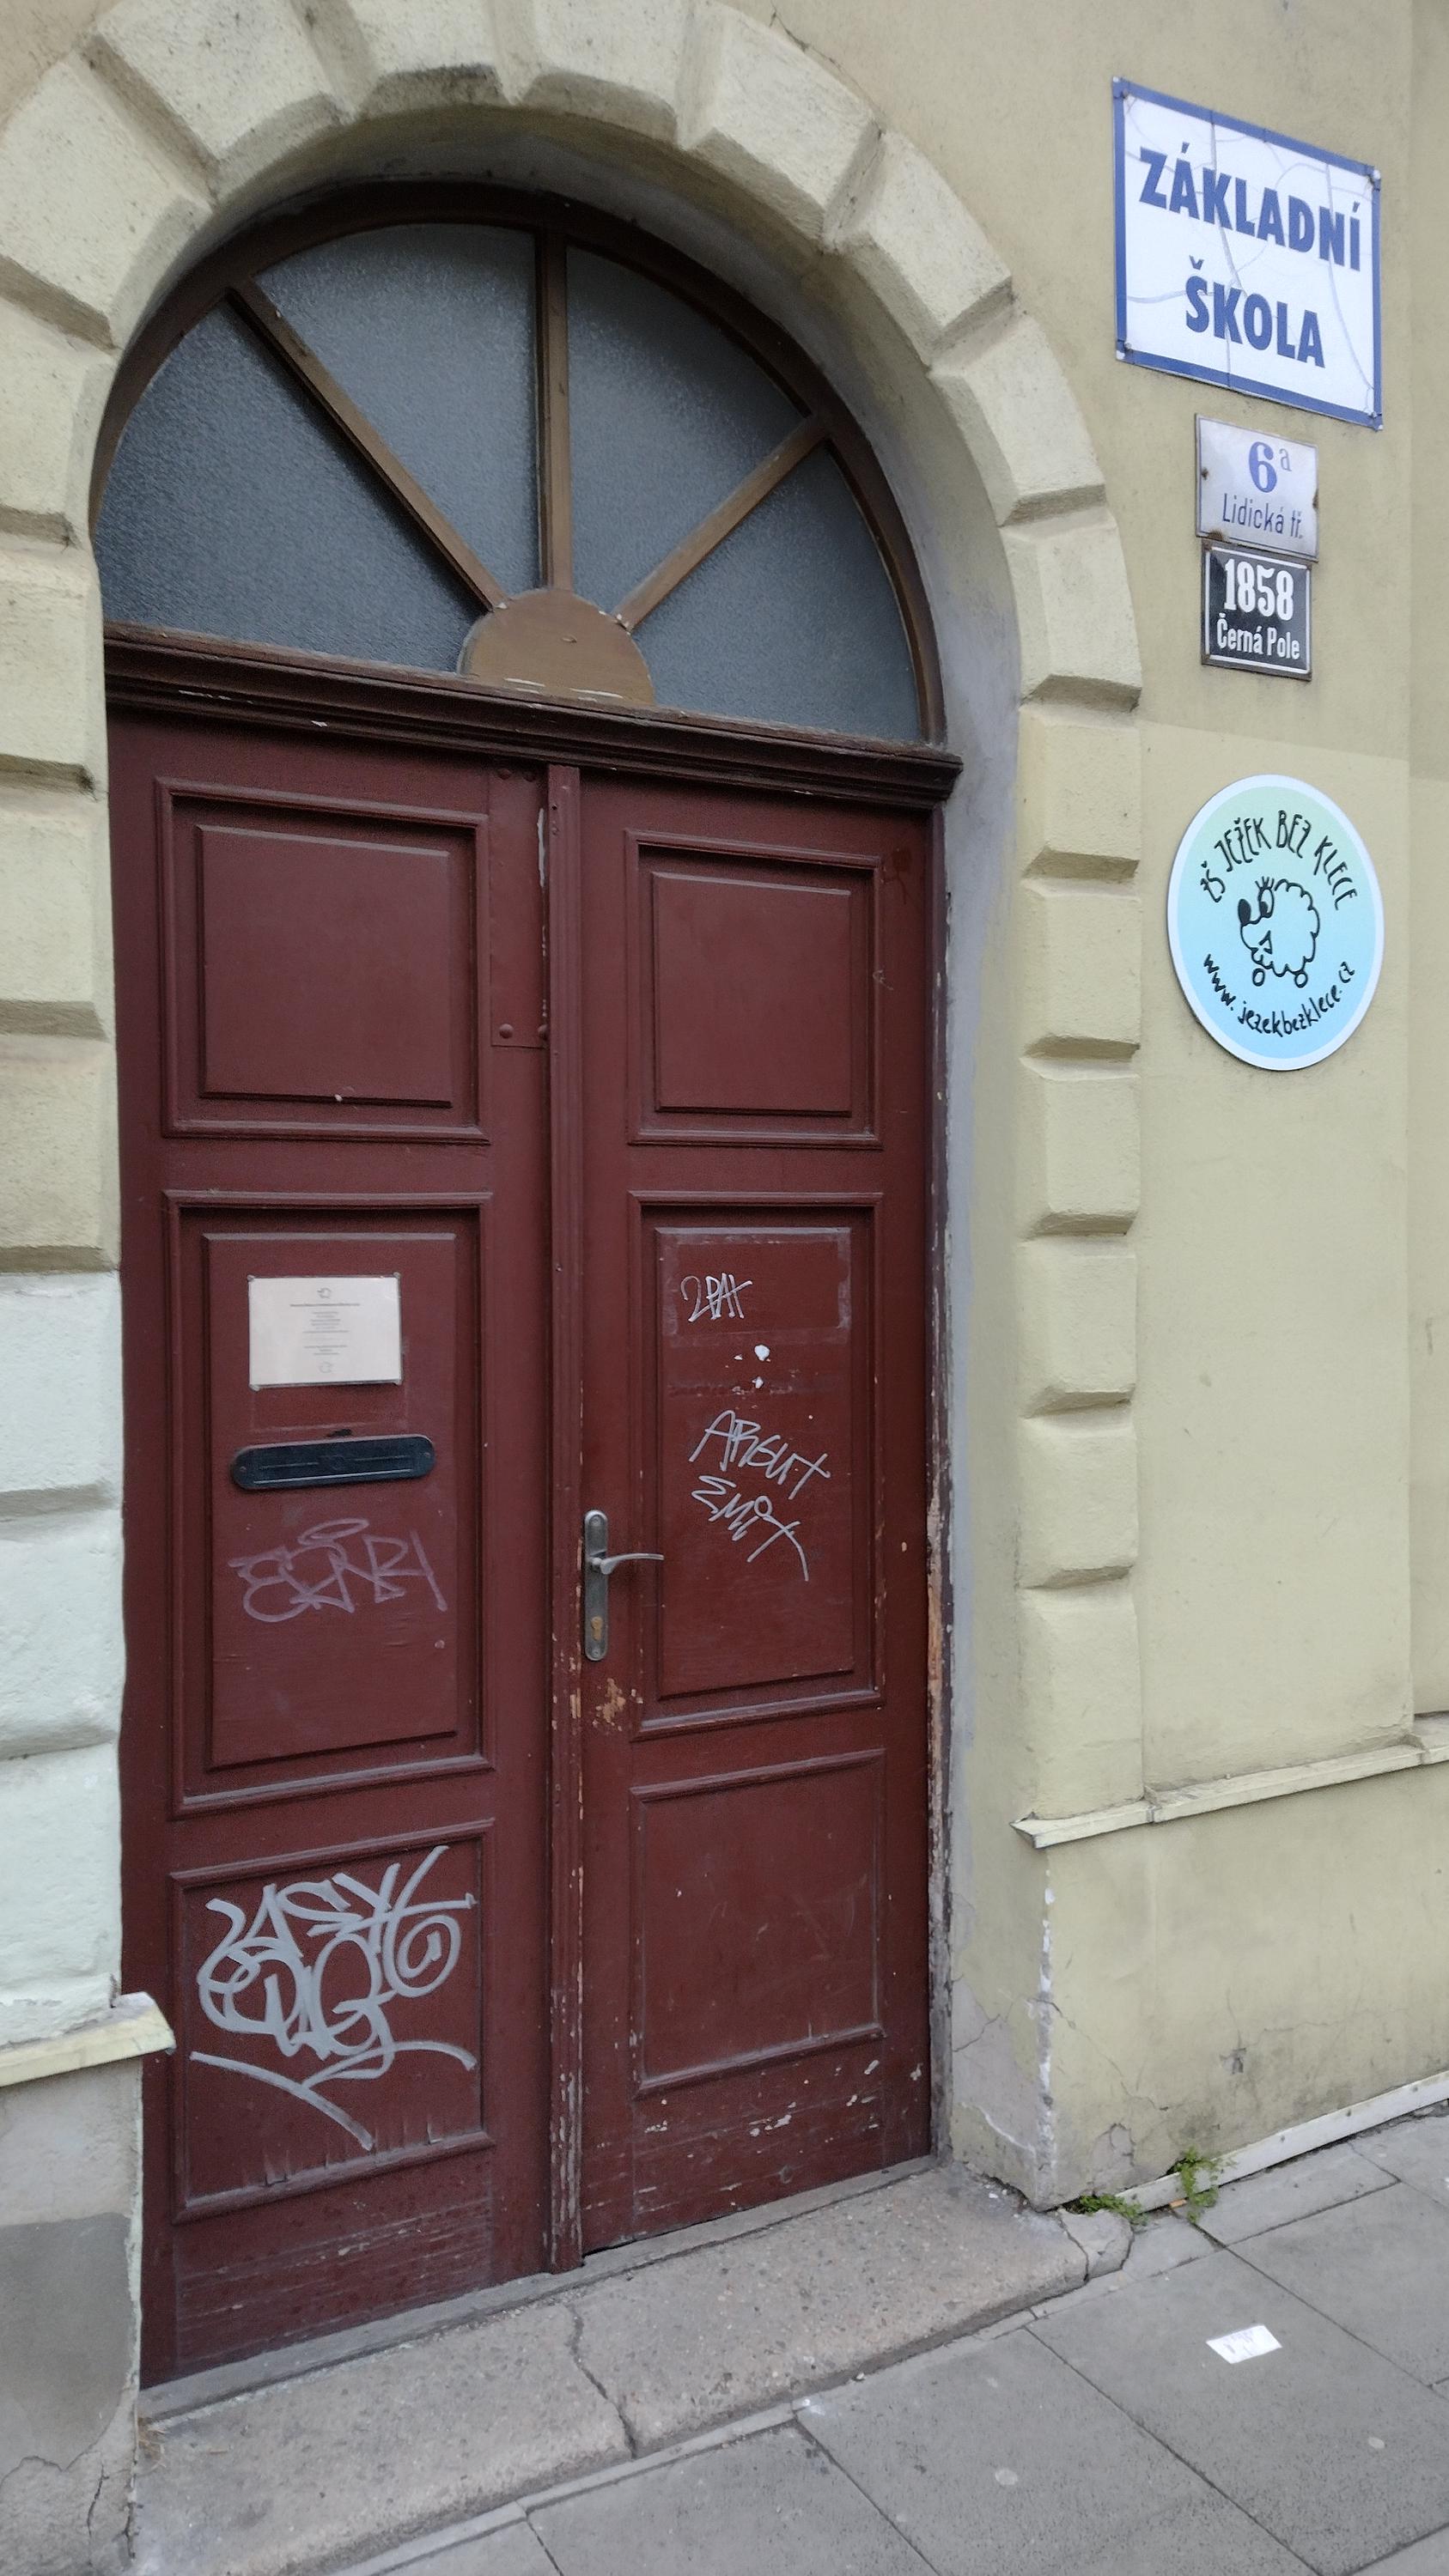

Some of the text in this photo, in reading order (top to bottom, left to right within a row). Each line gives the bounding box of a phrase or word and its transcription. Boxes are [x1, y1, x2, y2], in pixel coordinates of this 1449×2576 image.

[1138, 141, 1361, 272] ZÁKLADNÍ
[1185, 255, 1325, 369] ŠKOLA
[1222, 493, 1304, 539] Lidická tř.
[1224, 558, 1294, 621] 1858
[1216, 612, 1300, 659] Černá Pole
[1214, 817, 1272, 872] JEŽEK
[1275, 810, 1312, 860] BEZ
[1313, 835, 1358, 912] KLECE
